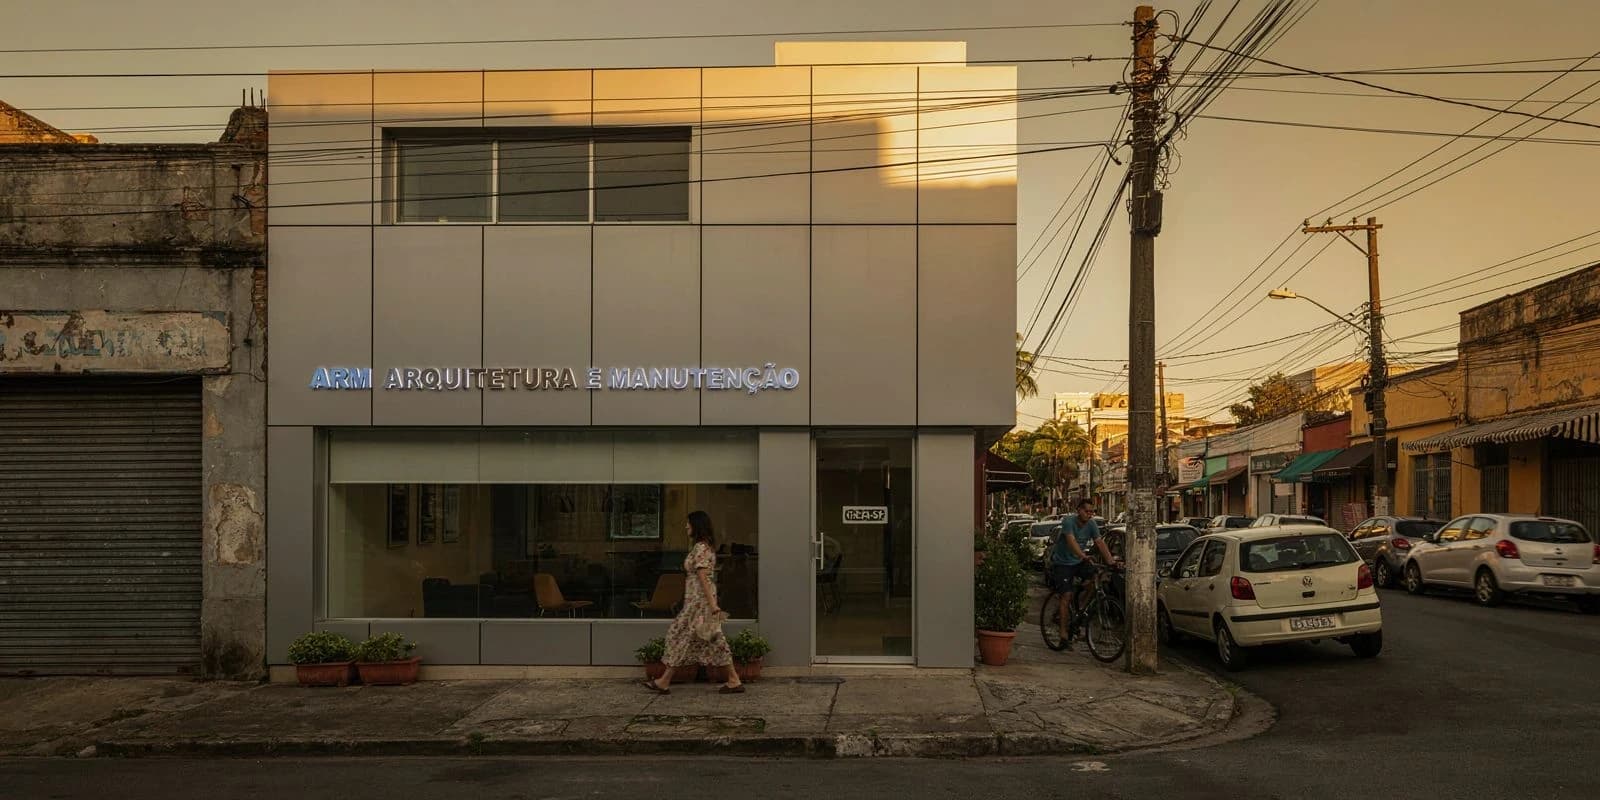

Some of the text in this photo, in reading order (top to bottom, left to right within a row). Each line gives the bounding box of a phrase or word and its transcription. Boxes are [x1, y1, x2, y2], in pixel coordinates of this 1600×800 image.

[309, 362, 799, 395] ARM ARQUITETURA E MANUTENÇÃO
